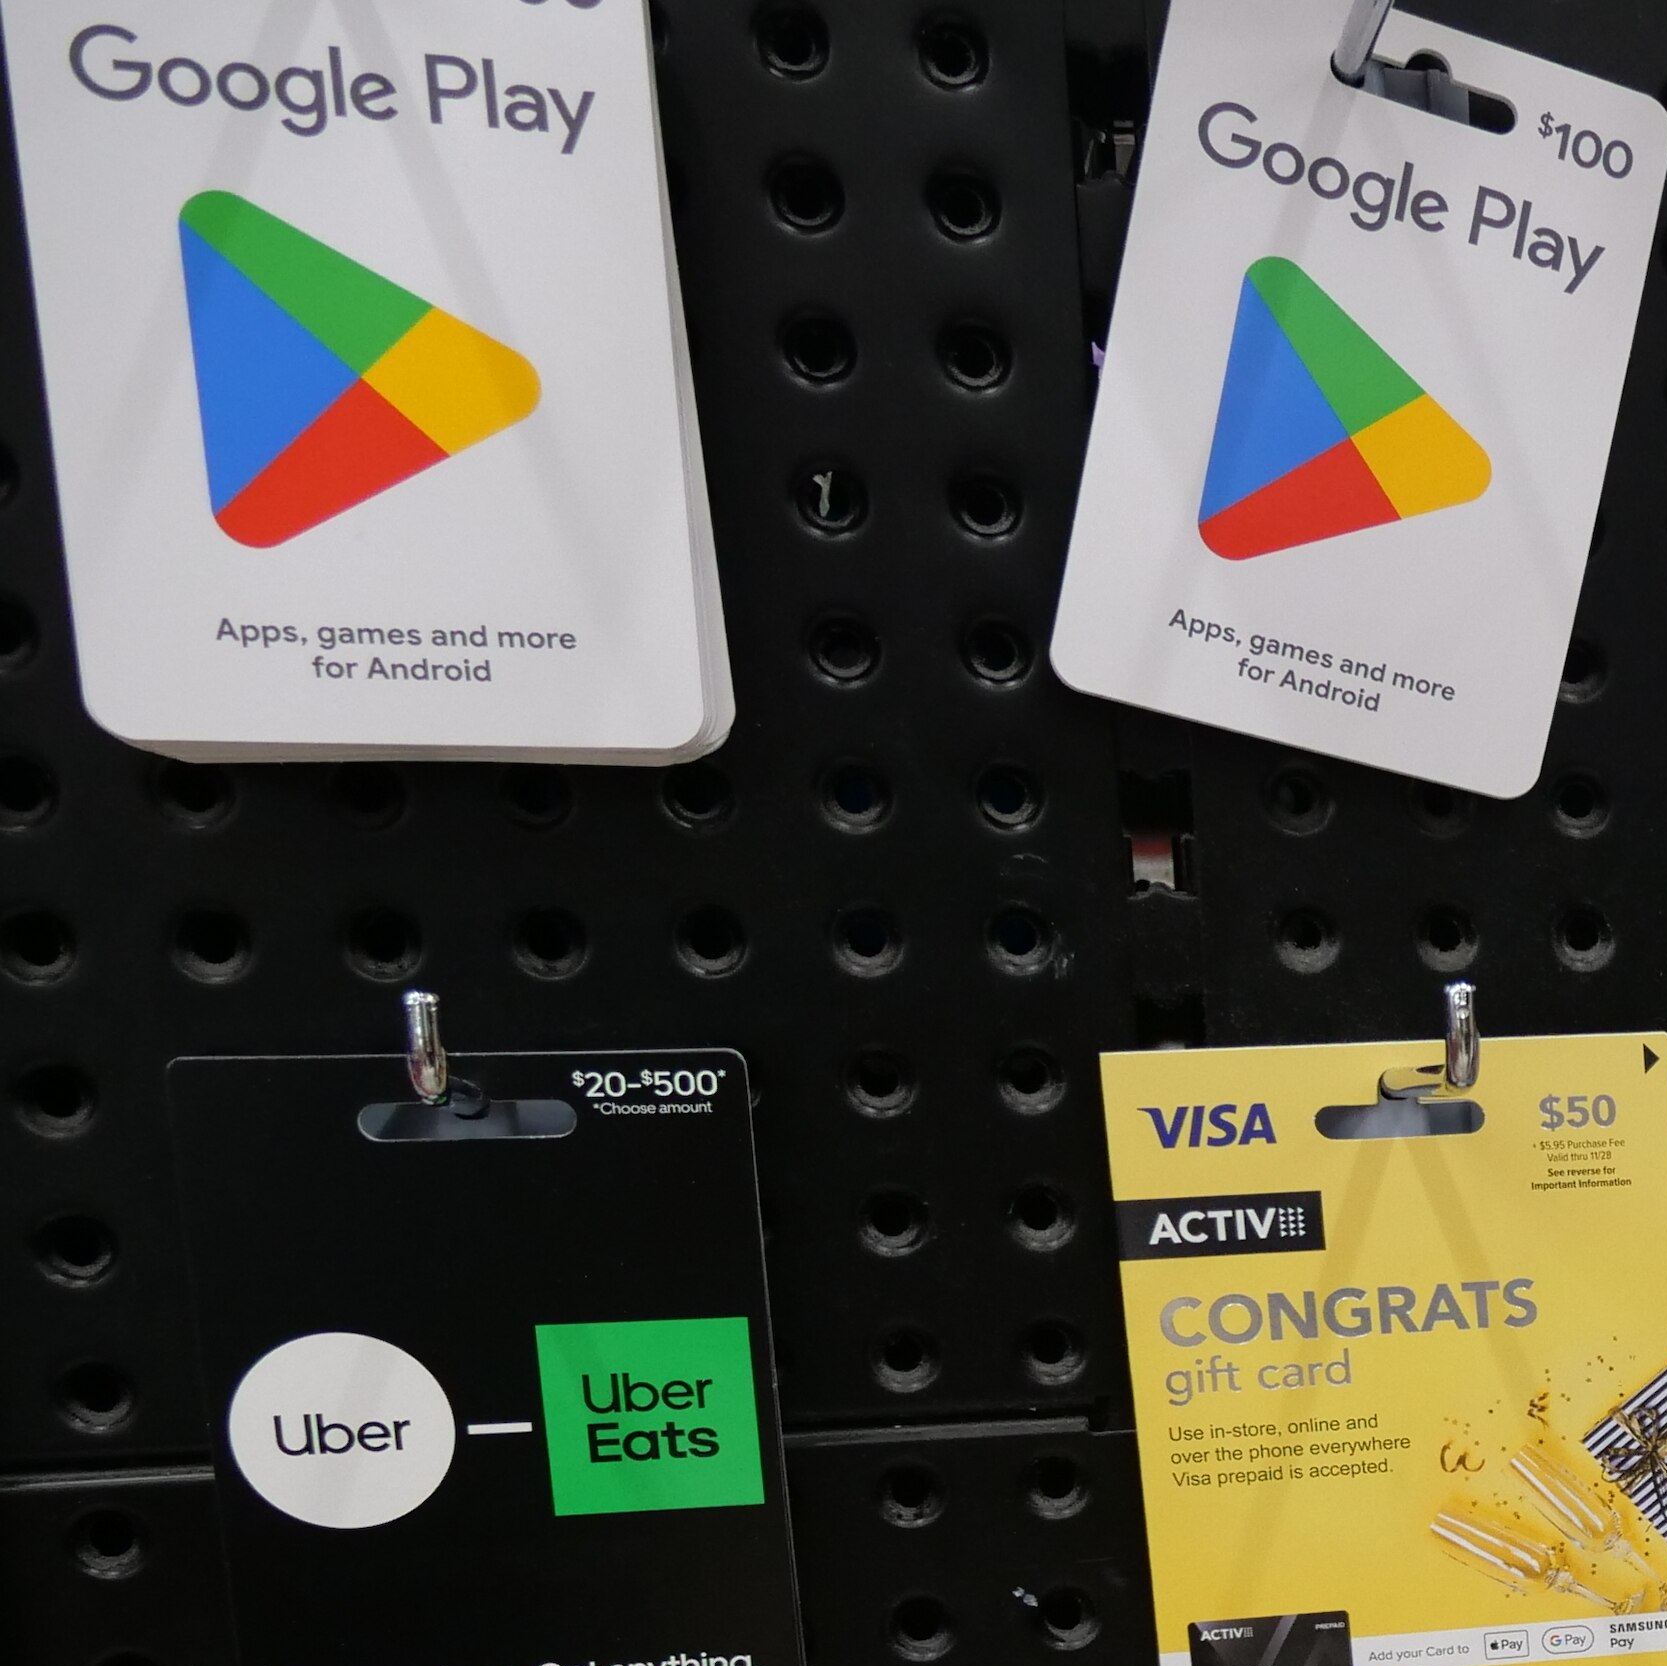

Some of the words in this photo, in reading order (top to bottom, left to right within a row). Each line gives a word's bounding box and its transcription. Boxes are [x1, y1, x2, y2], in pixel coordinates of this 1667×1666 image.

[68, 24, 399, 137] Google
[424, 53, 596, 154] Play
[1538, 112, 1633, 179] $100
[1198, 101, 1449, 232] Google
[1469, 186, 1605, 294] Play
[216, 617, 309, 648] Apps,
[317, 623, 423, 650] games
[431, 623, 487, 648] and
[498, 629, 577, 650] more
[312, 655, 358, 680] for
[368, 656, 492, 683] Android
[1137, 1103, 1277, 1148] VISA
[1539, 1094, 1617, 1131] $50
[1531, 1180, 1576, 1192] Important
[1579, 1178, 1632, 1189] Information
[1149, 1209, 1278, 1245] ACTIV
[1160, 1279, 1538, 1348] CONGRATS
[581, 1373, 712, 1413] Uber
[1166, 1357, 1244, 1407] gift
[1258, 1350, 1352, 1390] card
[274, 1413, 411, 1456] Uber
[589, 1422, 720, 1463] Eats
[1168, 1425, 1205, 1442] Use
[1210, 1420, 1283, 1439] in-store,
[1288, 1418, 1348, 1433] online
[1352, 1415, 1378, 1430] and
